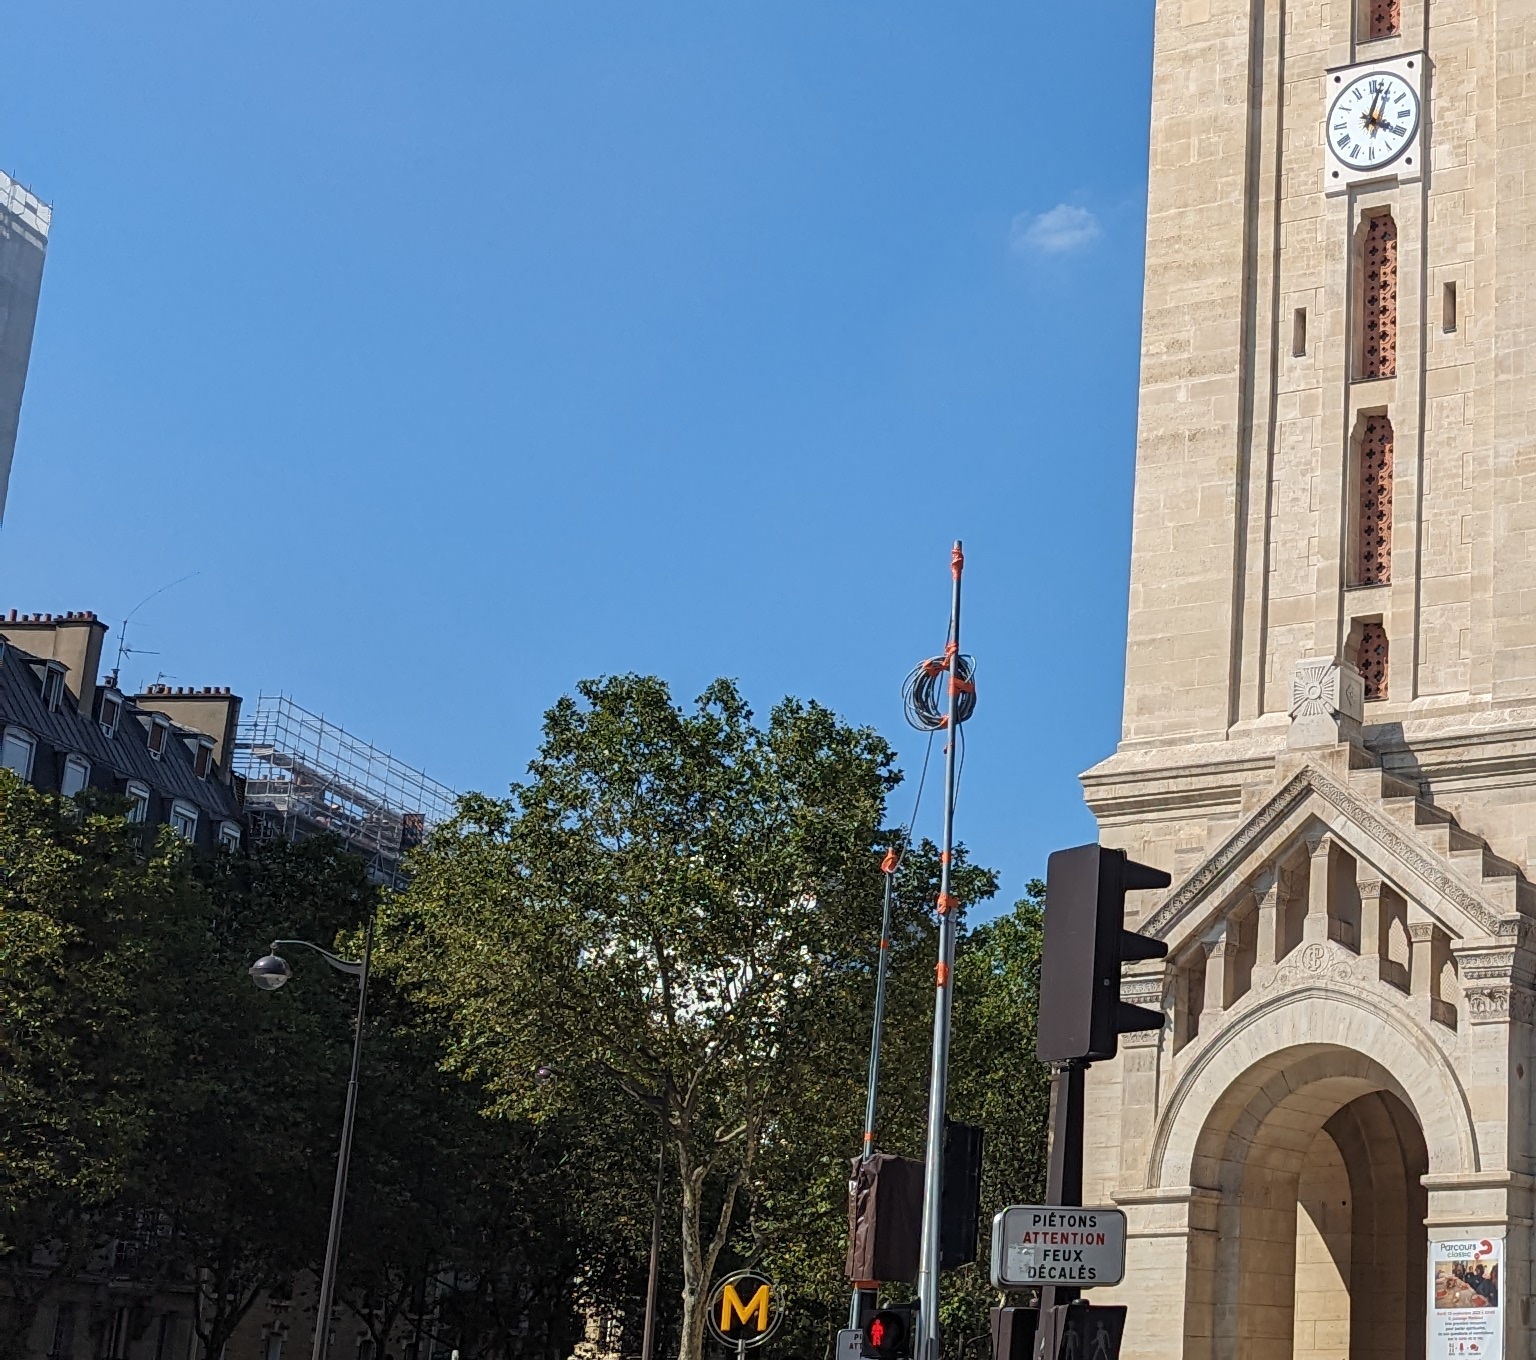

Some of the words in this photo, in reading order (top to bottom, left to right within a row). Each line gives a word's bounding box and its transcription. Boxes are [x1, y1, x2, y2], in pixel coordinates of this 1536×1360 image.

[1032, 1212, 1097, 1228] PIÉTONS
[1022, 1231, 1105, 1245] ATTENTION
[1440, 1243, 1477, 1252] Parcours
[1043, 1249, 1083, 1262] FEUX
[1028, 1264, 1097, 1280] DÉCALÉS
[720, 1284, 770, 1331] M
